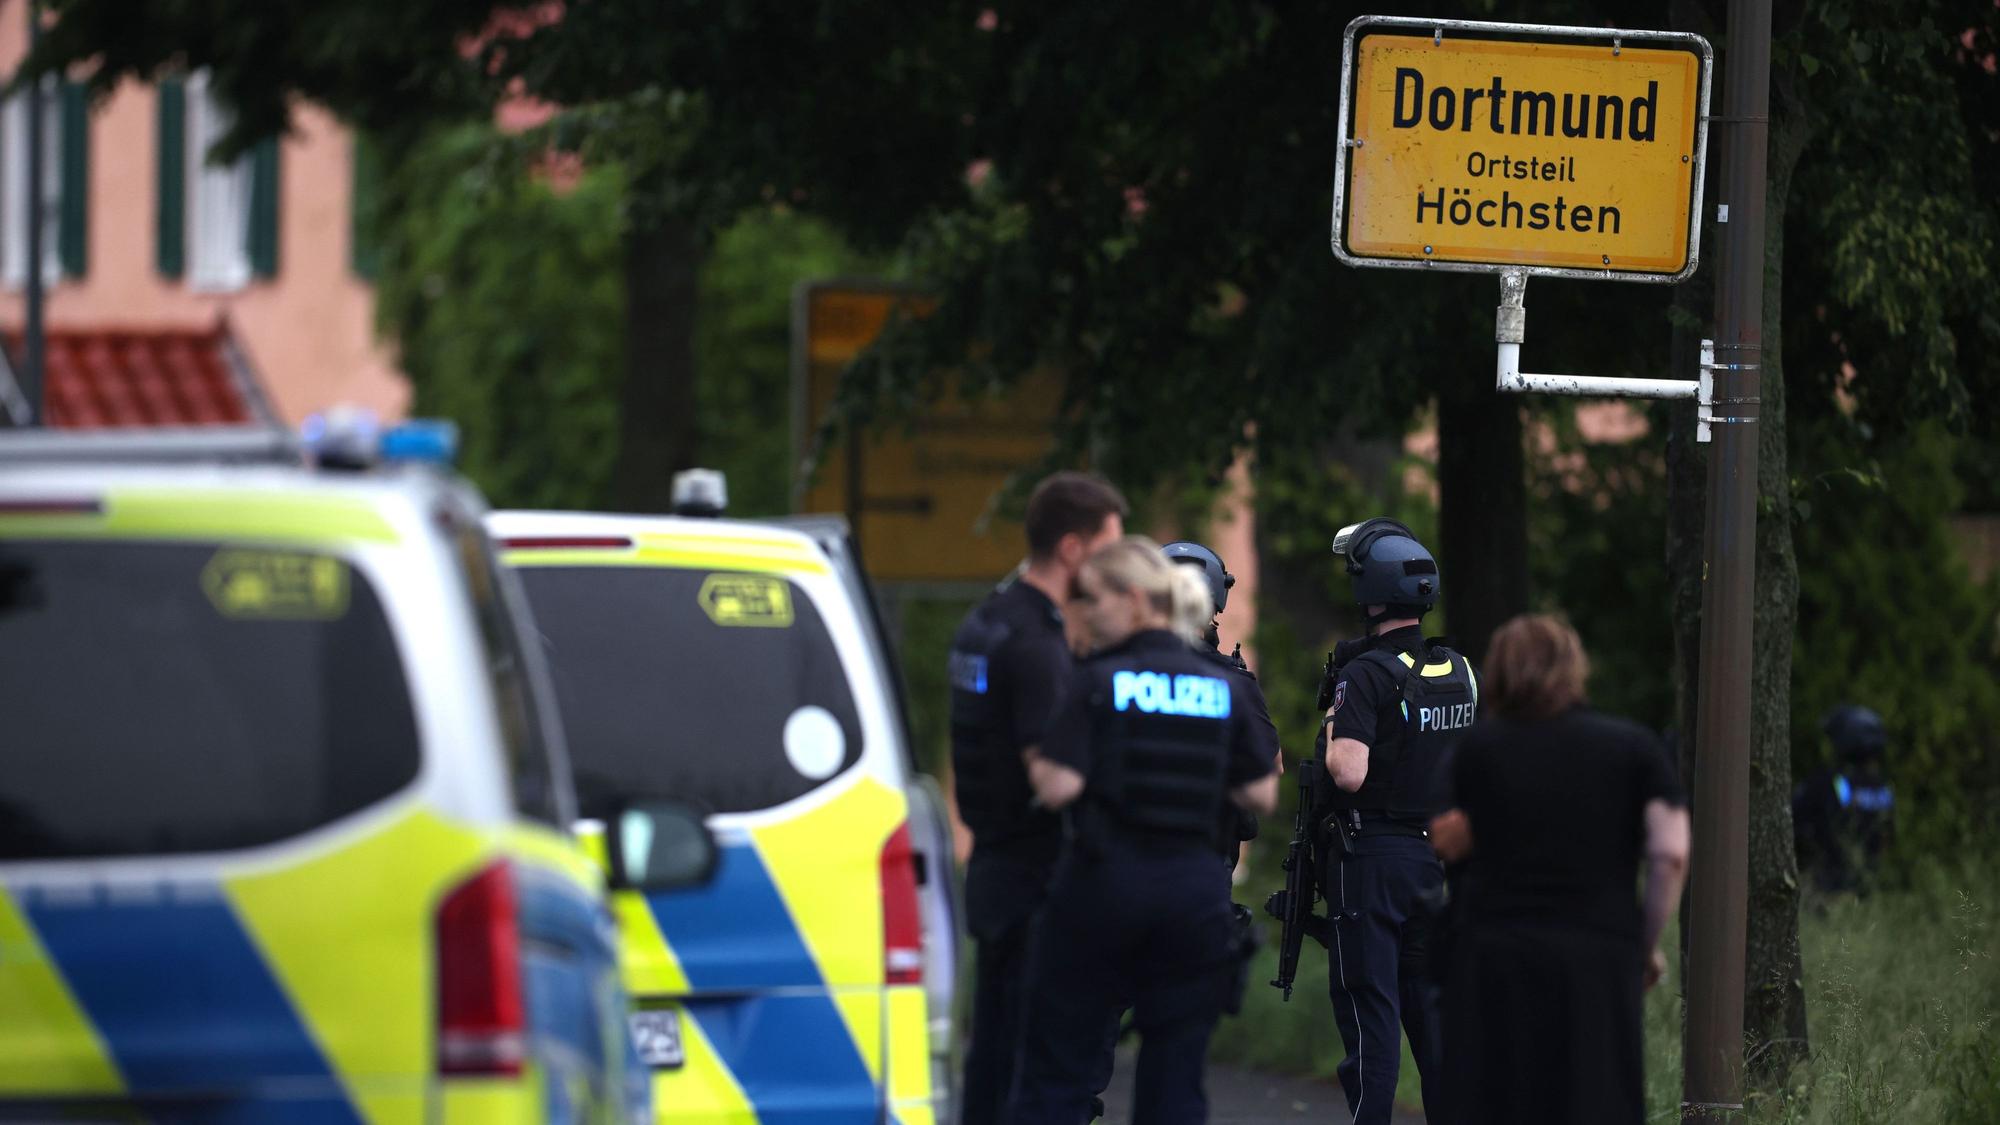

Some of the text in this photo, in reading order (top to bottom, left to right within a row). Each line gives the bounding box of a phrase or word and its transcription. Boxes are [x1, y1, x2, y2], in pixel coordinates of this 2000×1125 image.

[1393, 67, 1658, 142] Dortmund
[1467, 152, 1575, 182] Ortsteil
[1416, 187, 1621, 234] Höchsten
[1113, 671, 1231, 719] POLIZEI
